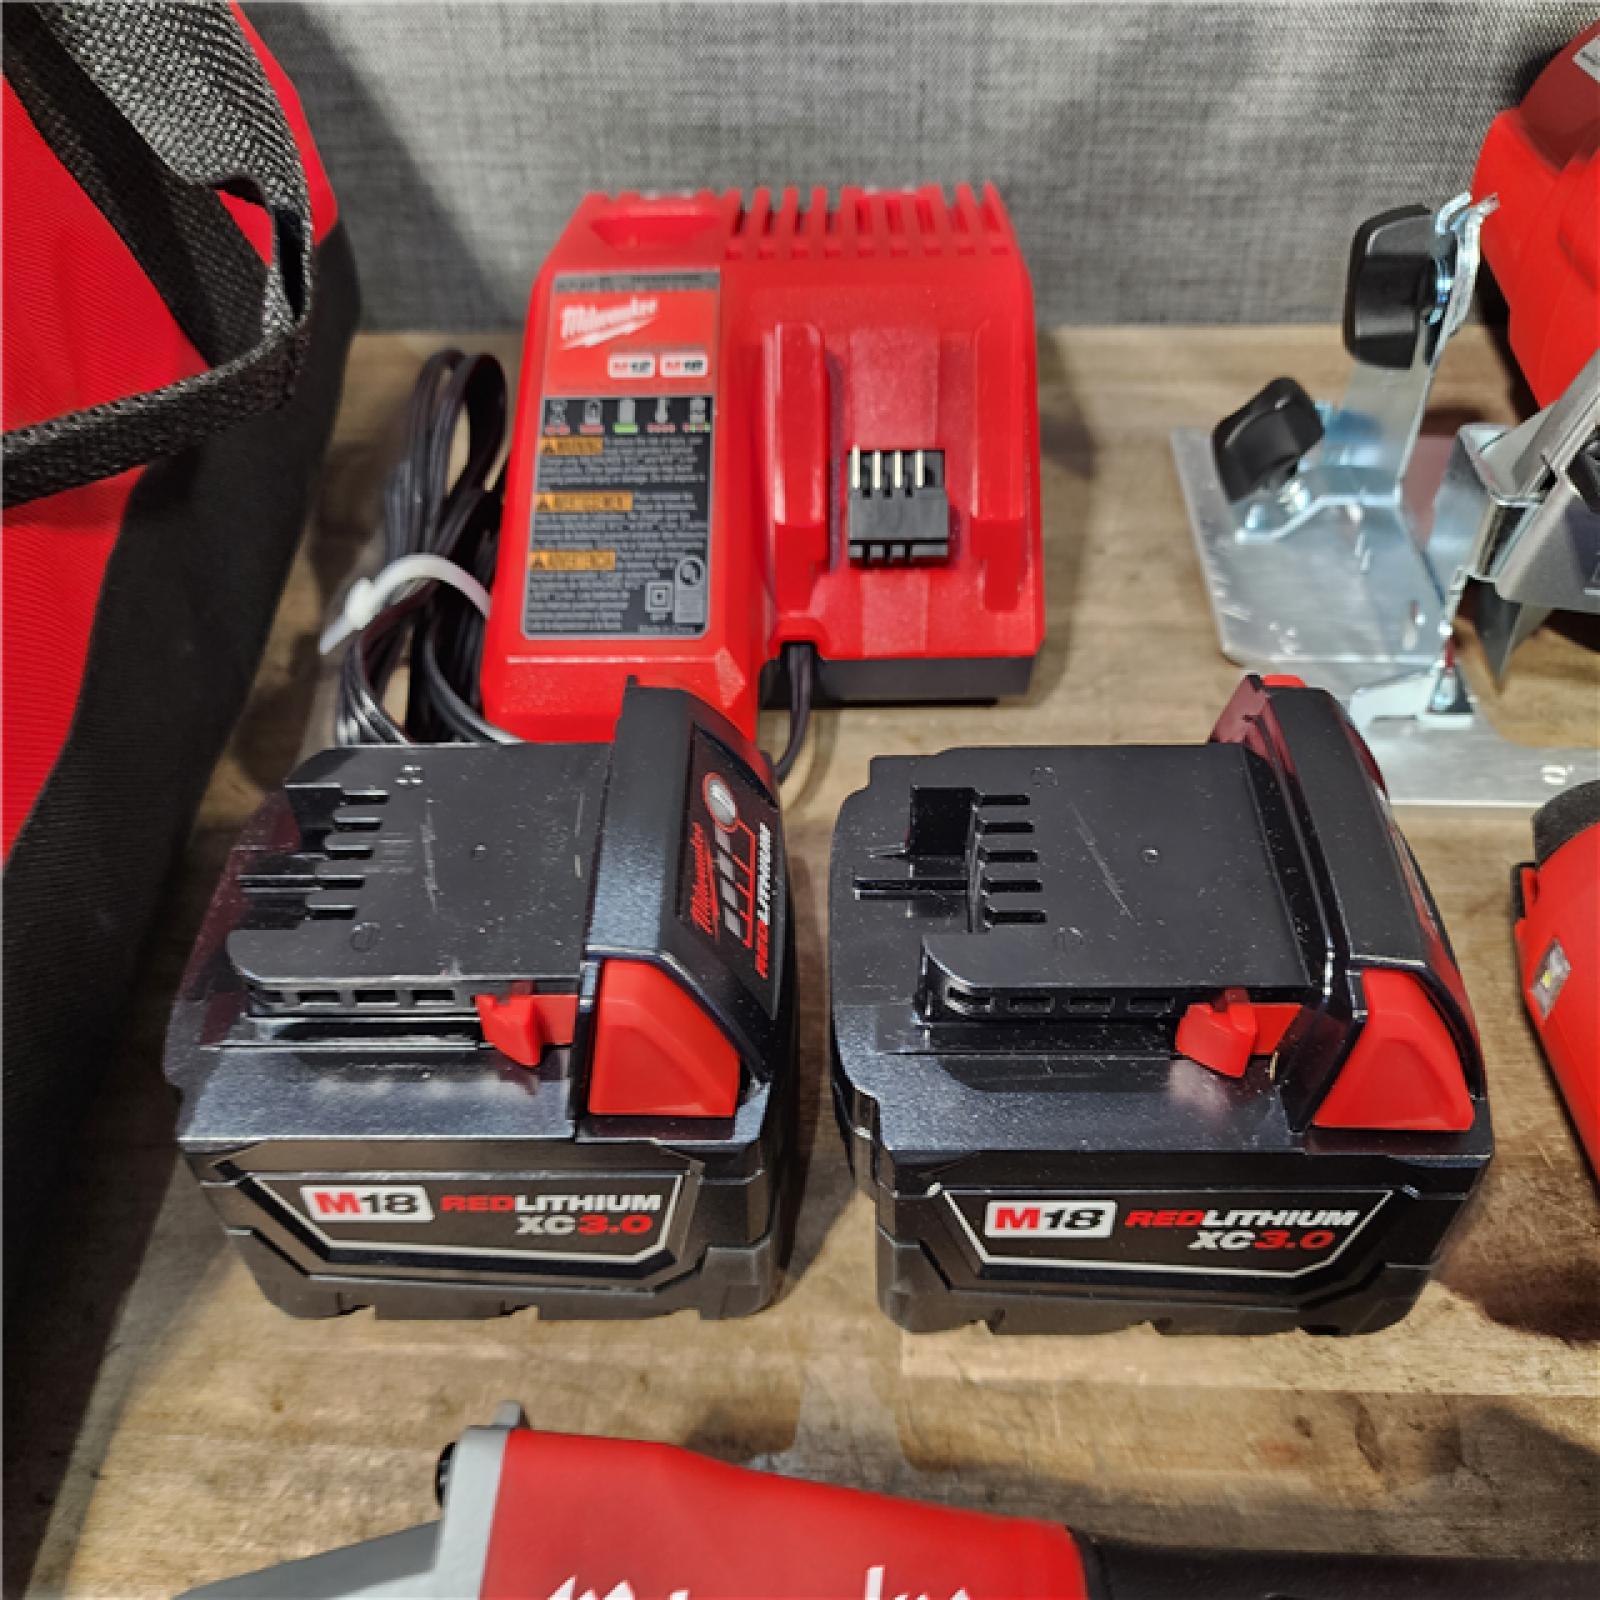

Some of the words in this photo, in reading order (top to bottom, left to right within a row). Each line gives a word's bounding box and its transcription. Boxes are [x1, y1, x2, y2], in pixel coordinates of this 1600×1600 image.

[755, 821, 772, 980] REDLITHIUM
[313, 1191, 419, 1215] M18
[440, 1193, 661, 1213] REDLITHIUM
[994, 1206, 1106, 1230] M18
[1124, 1209, 1360, 1229] REDLITHIUM
